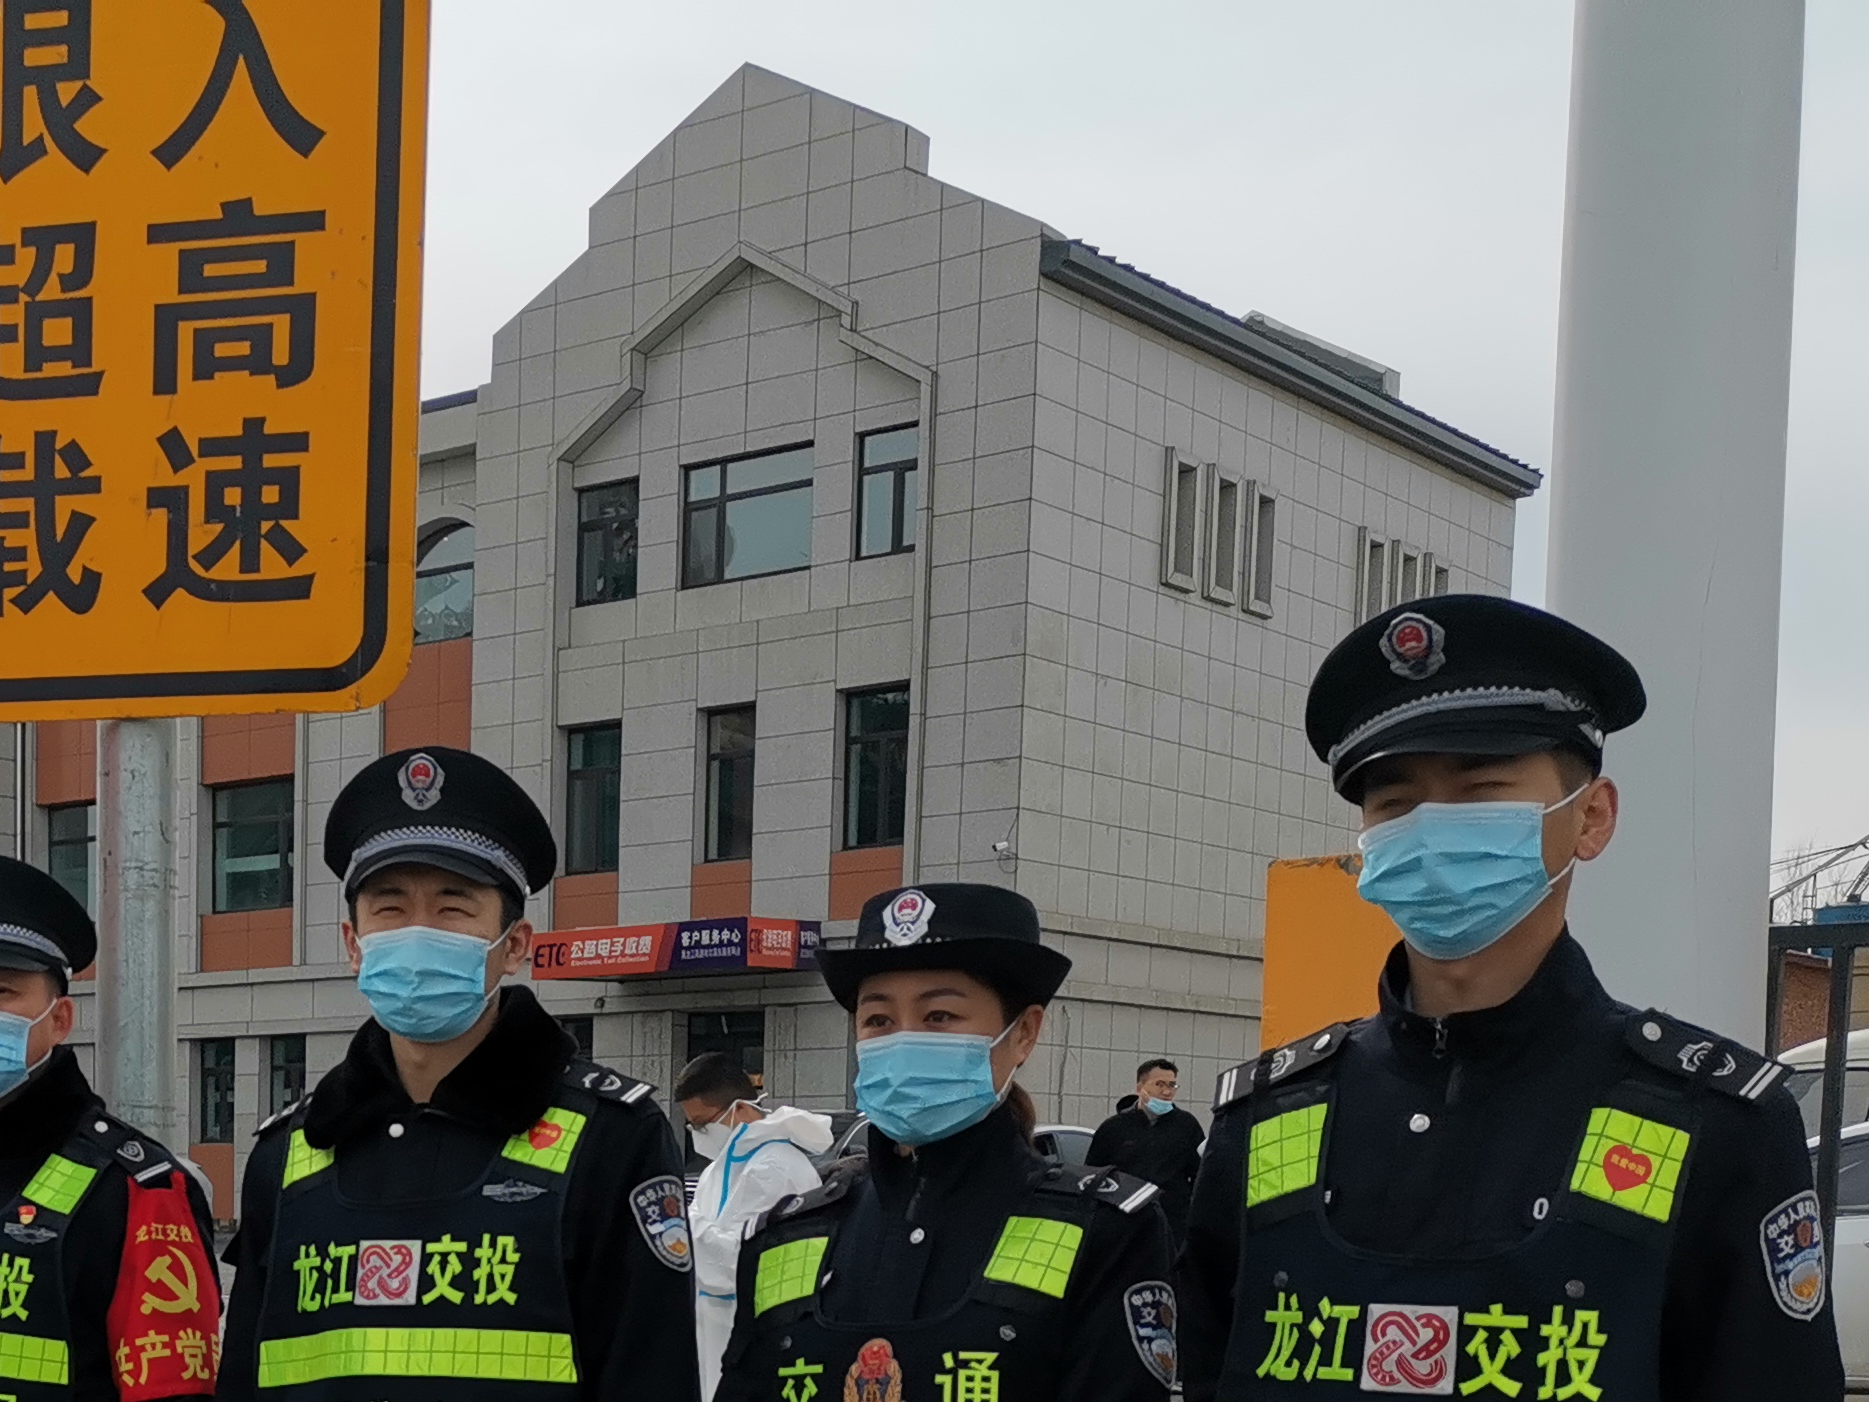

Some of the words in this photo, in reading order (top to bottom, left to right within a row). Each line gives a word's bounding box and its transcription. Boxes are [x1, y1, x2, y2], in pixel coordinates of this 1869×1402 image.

[571, 936, 652, 959] 公路电子收费
[681, 927, 741, 947] 客户服务中心
[534, 943, 568, 968] ETC
[293, 1240, 357, 1314] 龙江
[421, 1233, 522, 1306] 交投
[1256, 1292, 1360, 1382] 龙江
[1458, 1303, 1608, 1402] 交投
